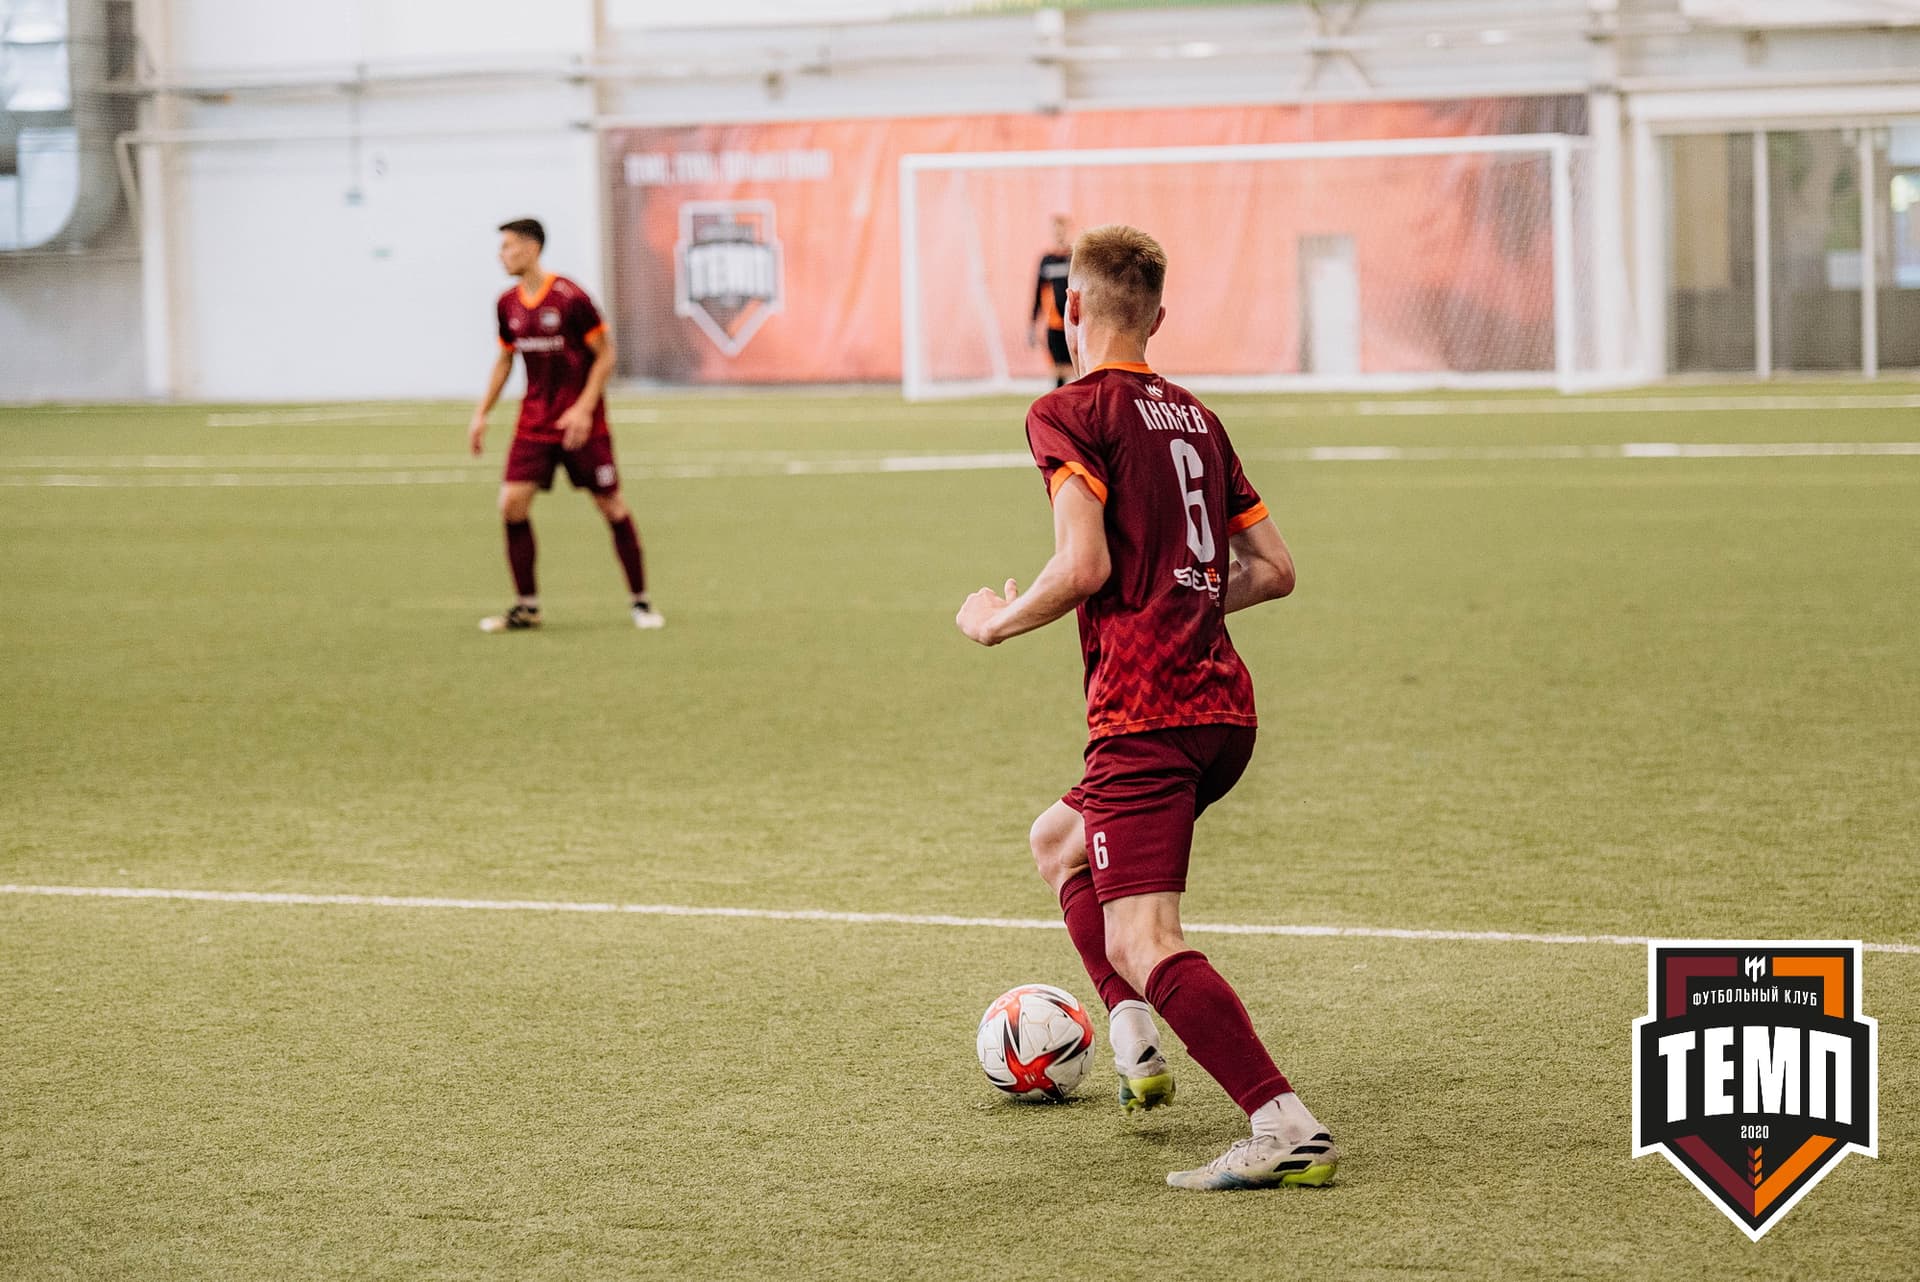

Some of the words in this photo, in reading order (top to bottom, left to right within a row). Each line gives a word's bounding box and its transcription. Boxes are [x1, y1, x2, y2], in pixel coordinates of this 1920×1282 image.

[1134, 399, 1208, 434] КНЯЗЕВ
[1170, 438, 1216, 563] 6
[1093, 832, 1109, 870] 6
